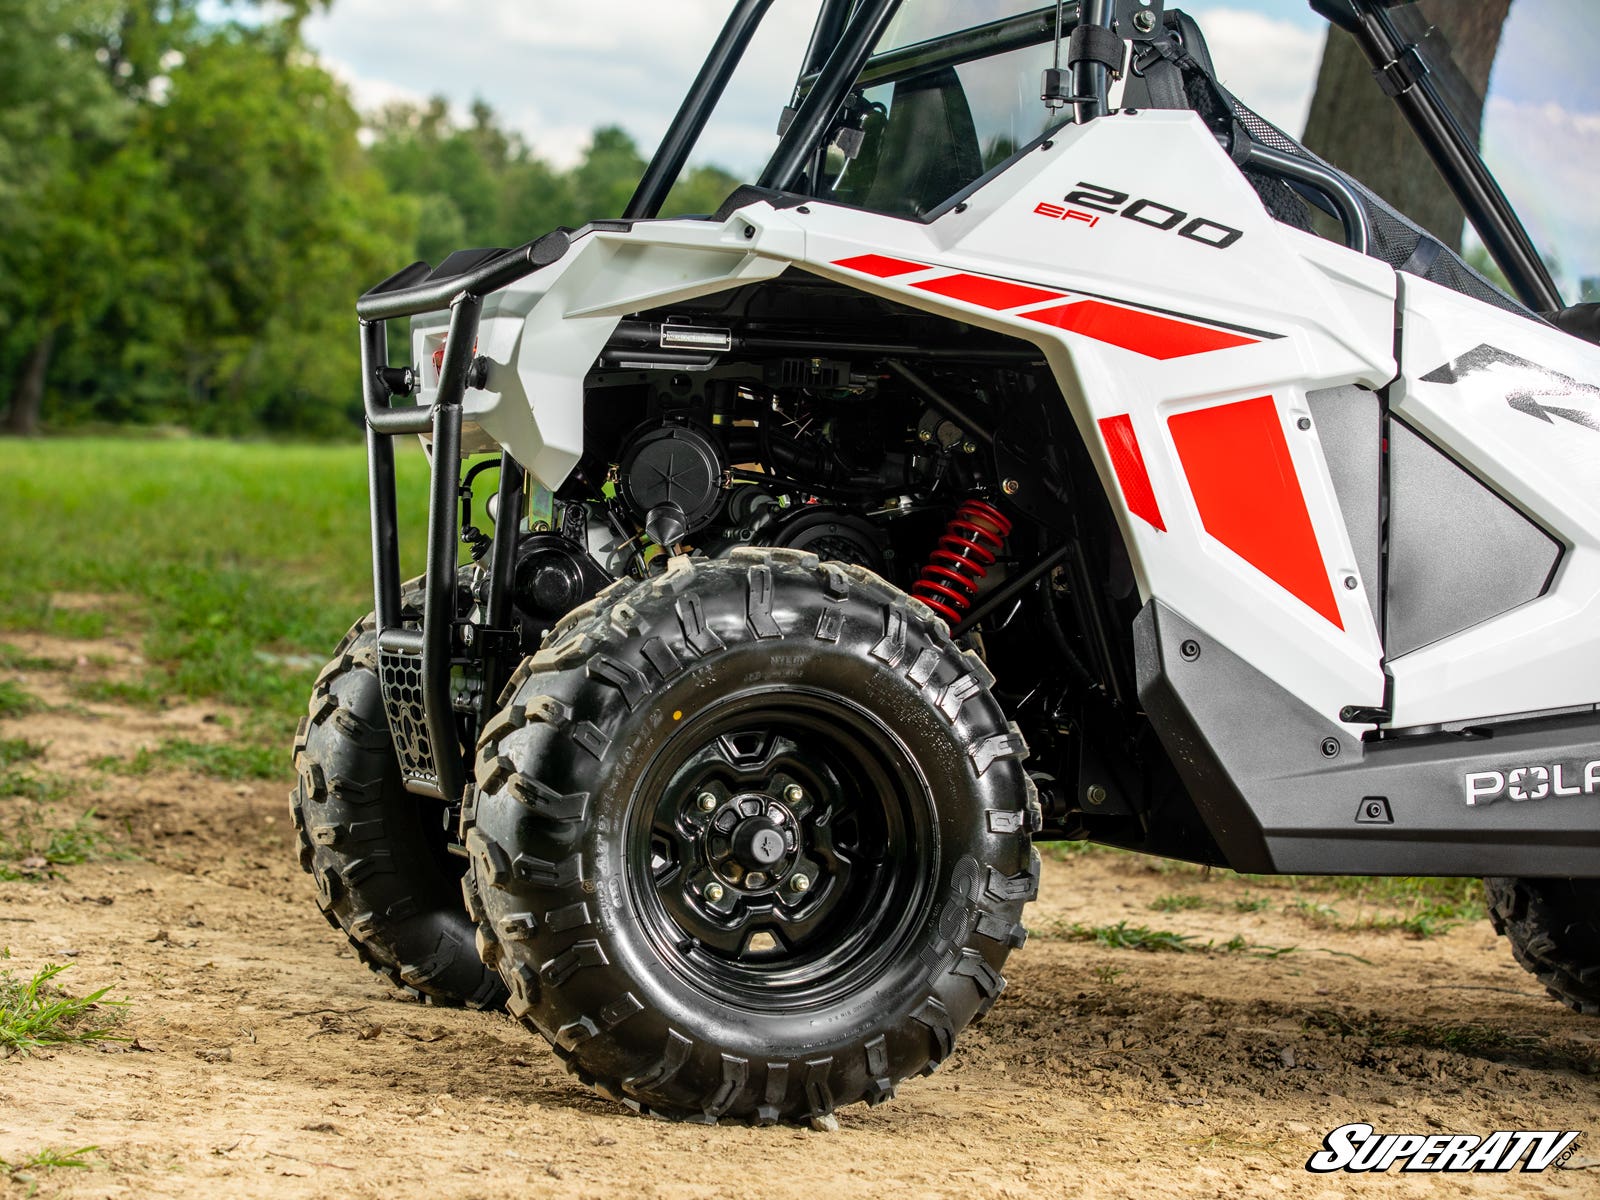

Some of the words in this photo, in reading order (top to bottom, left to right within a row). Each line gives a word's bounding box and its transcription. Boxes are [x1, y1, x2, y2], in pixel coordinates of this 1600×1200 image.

[1033, 202, 1100, 227] EFI
[1064, 182, 1244, 249] 200
[919, 855, 980, 988] CST
